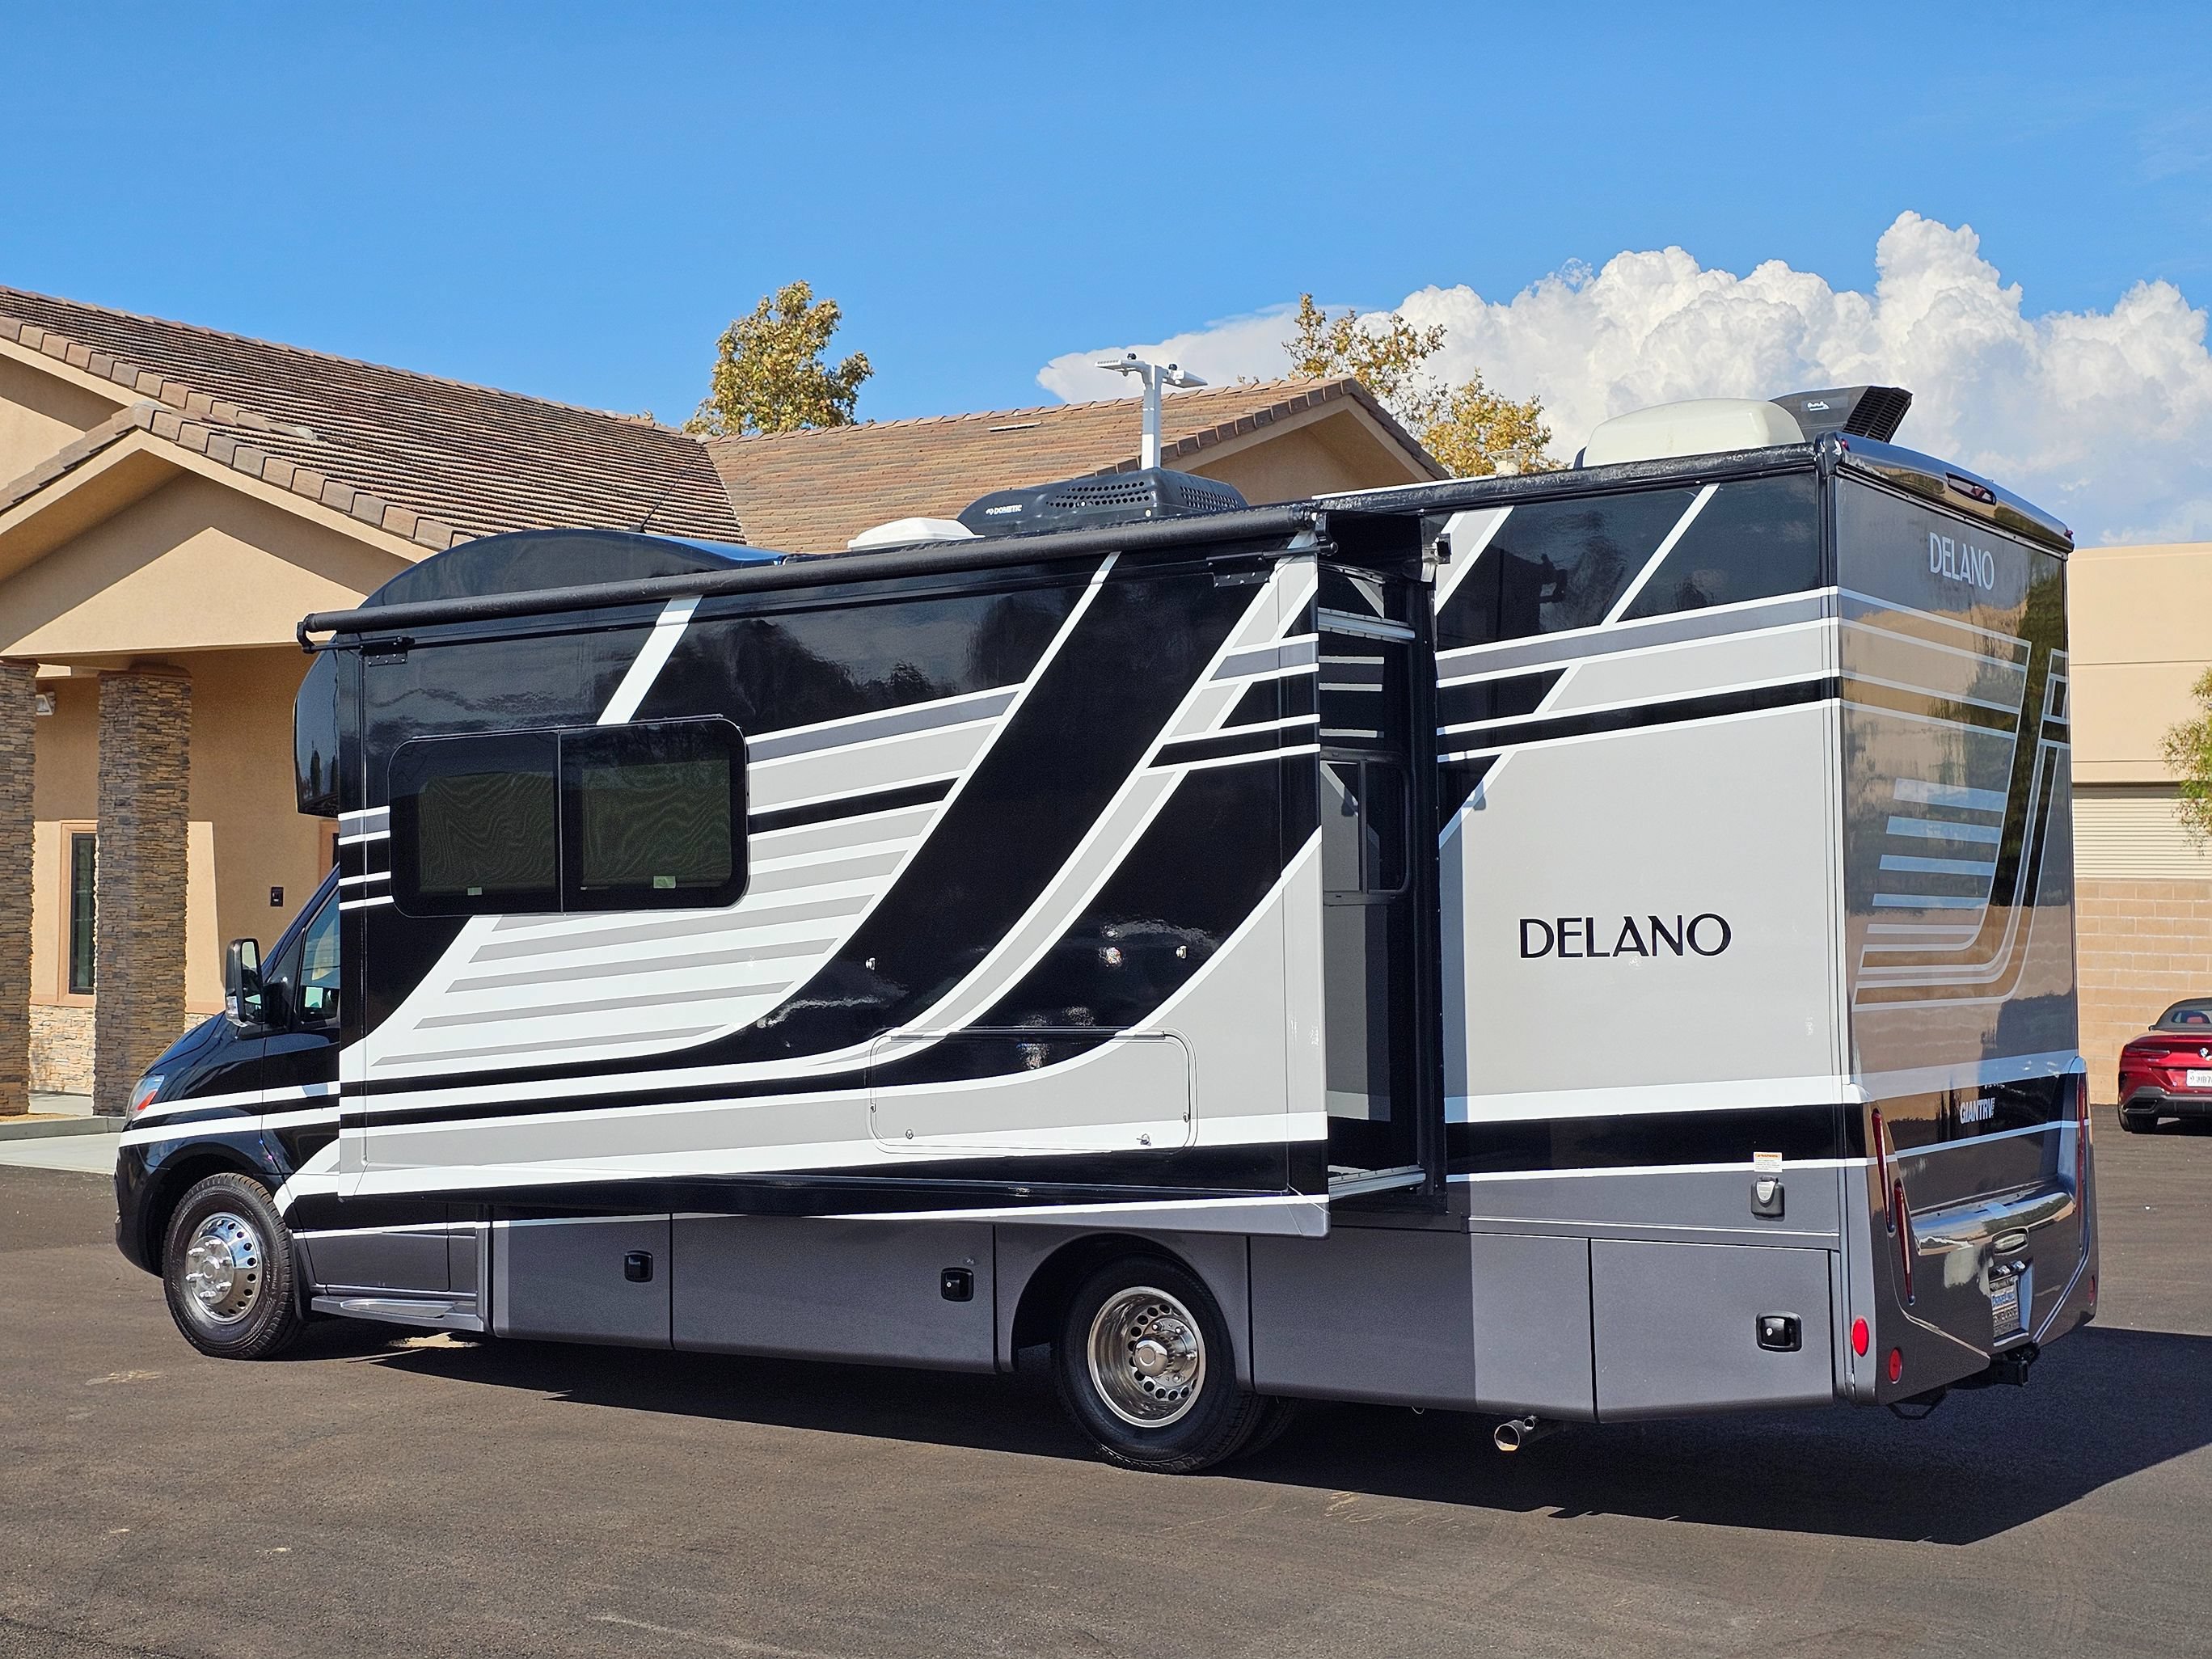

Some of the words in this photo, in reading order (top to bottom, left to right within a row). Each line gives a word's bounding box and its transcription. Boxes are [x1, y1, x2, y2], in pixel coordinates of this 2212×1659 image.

[994, 504, 1023, 515] DOMETIC
[1928, 531, 1995, 591] DELANO
[1519, 913, 1732, 958] DELANO
